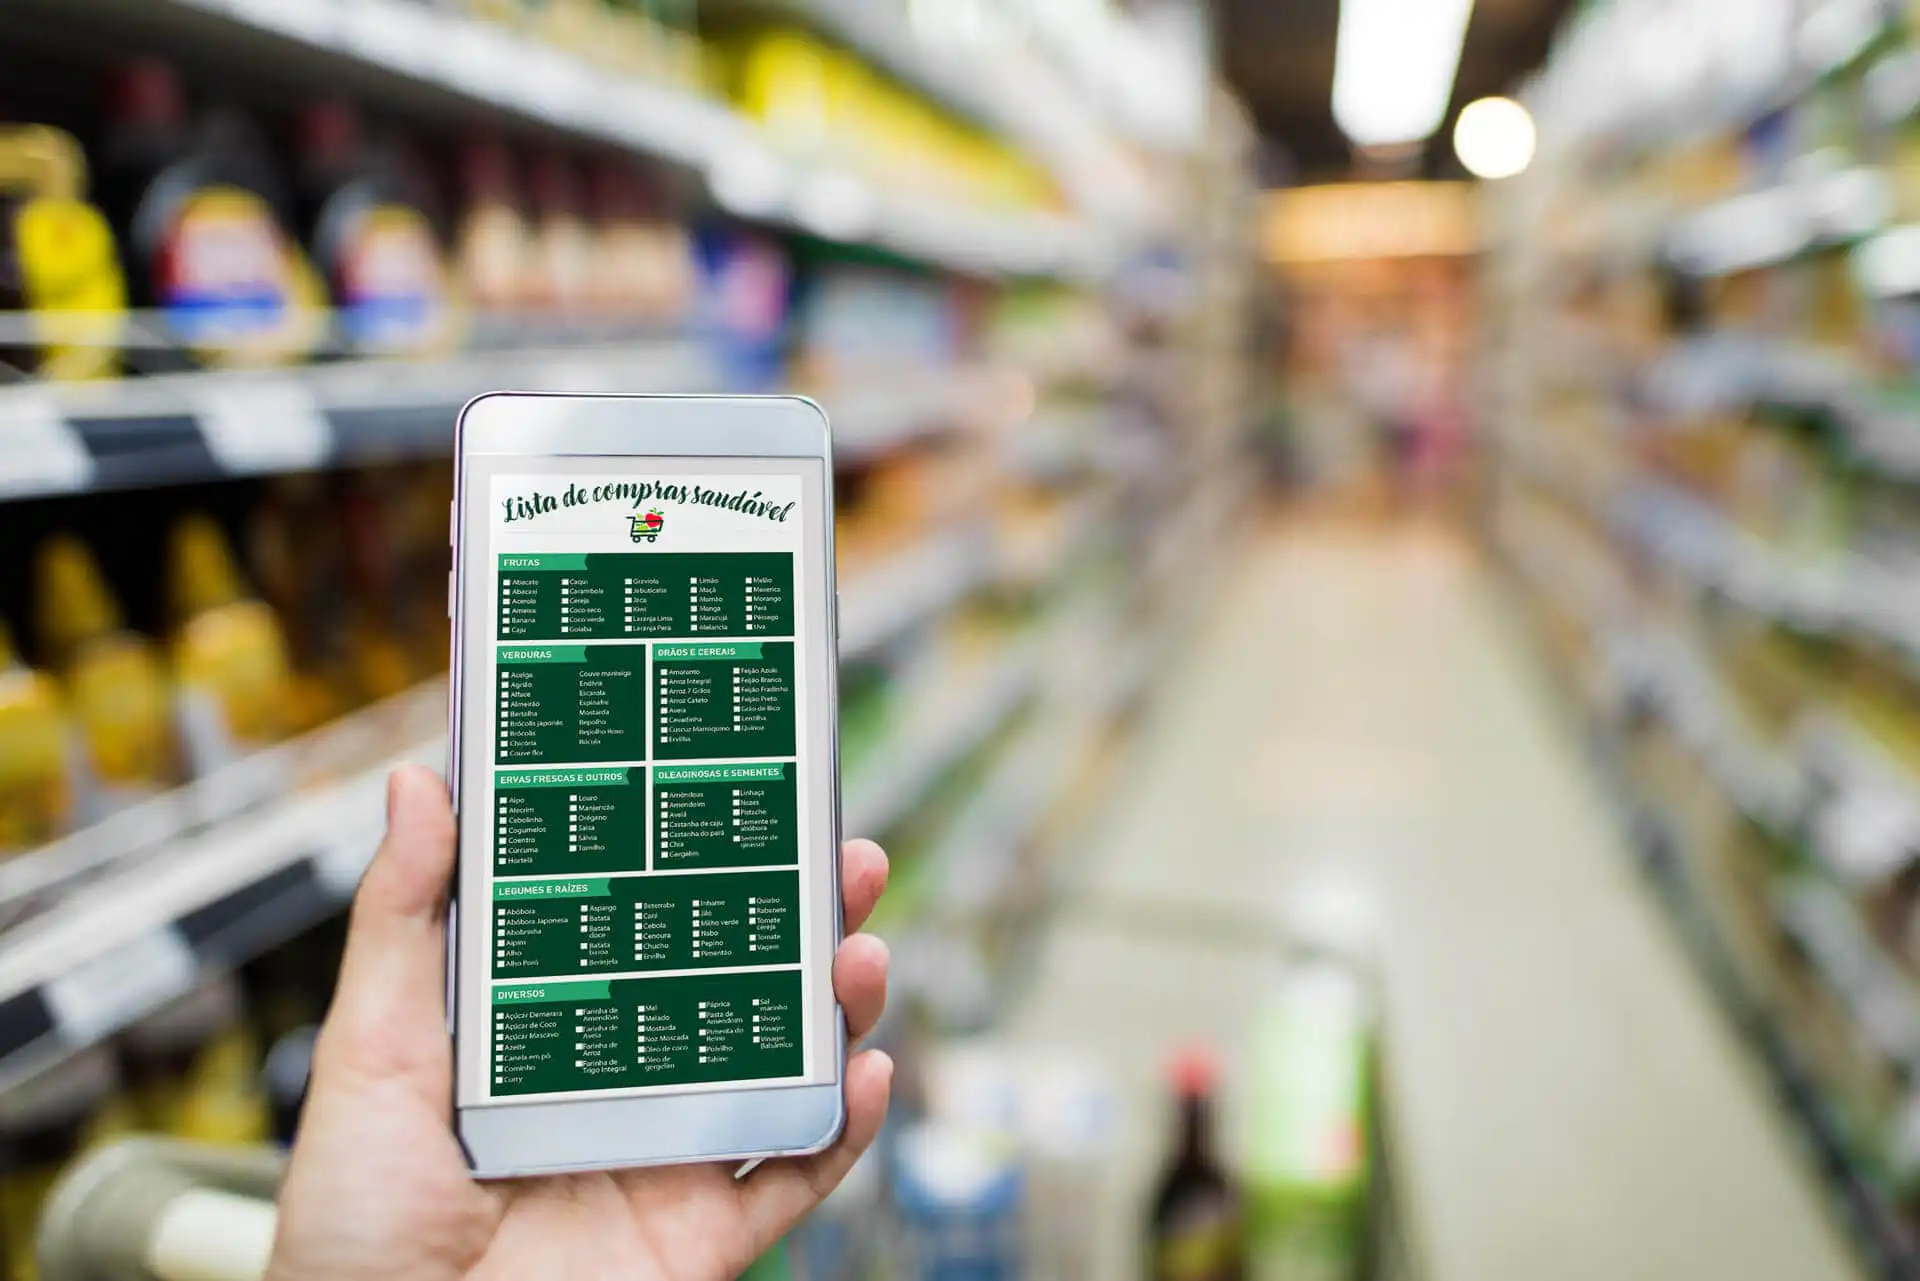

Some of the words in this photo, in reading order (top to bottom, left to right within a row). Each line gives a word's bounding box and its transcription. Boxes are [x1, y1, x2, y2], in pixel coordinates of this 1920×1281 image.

[502, 490, 558, 523] Lista
[563, 483, 588, 507] de
[592, 479, 687, 508] compras
[690, 484, 797, 523] saudável
[503, 651, 552, 659] VERDURAS
[731, 768, 779, 776] SEMENTES
[501, 776, 530, 784] ERVAS
[534, 774, 575, 783] FRESCAS
[499, 886, 544, 895] LEGUMES
[555, 883, 588, 893] RAÍZES
[498, 990, 544, 999] DIVERSOS
